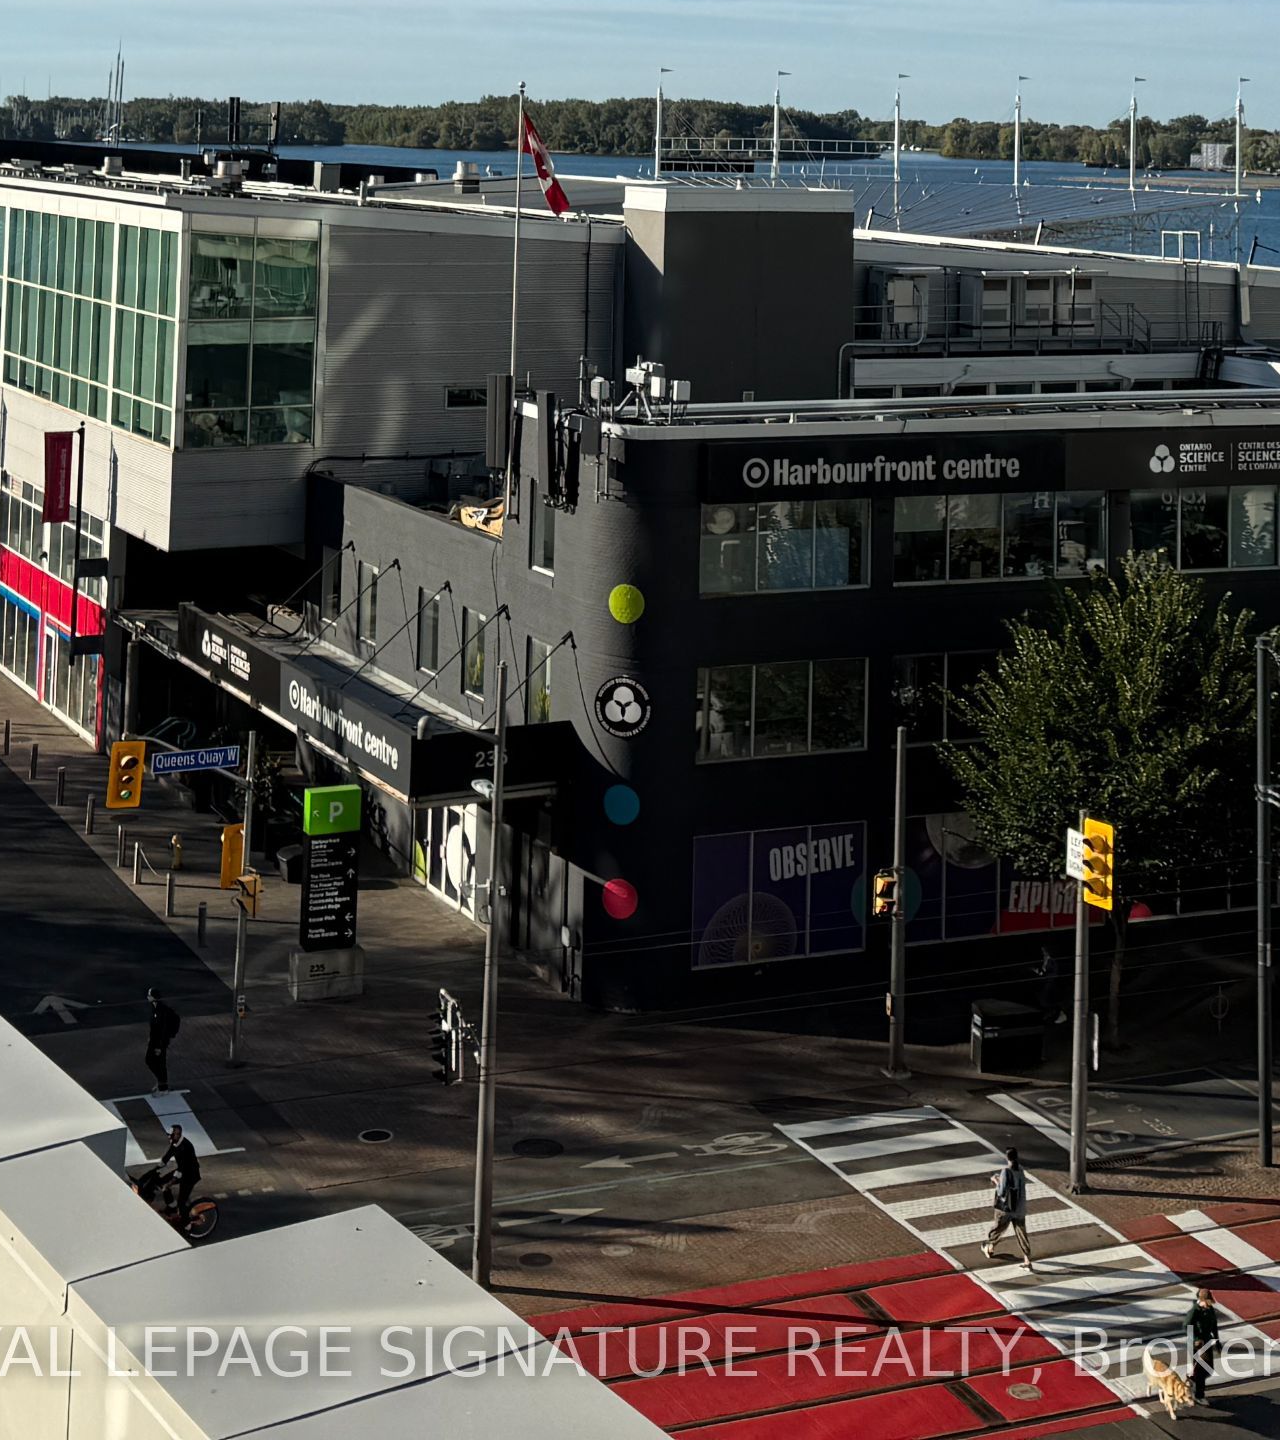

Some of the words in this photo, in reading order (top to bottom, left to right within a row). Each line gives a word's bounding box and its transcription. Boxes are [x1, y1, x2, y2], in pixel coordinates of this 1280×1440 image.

[1179, 443, 1212, 452] ONTARIO
[1238, 442, 1265, 450] CENTRE
[1179, 452, 1225, 463] SCIENCE
[1179, 464, 1207, 472] CENTRE
[773, 454, 937, 486] Harbourfront
[942, 453, 1020, 480] centre
[300, 686, 363, 747] Harbourfront
[365, 730, 398, 770] centre
[156, 754, 195, 769] Queens
[198, 751, 224, 766] Quay
[227, 748, 237, 761] W
[328, 801, 344, 823] P
[769, 833, 855, 882] OBSERVE
[1008, 880, 1077, 914] EXPLOR
